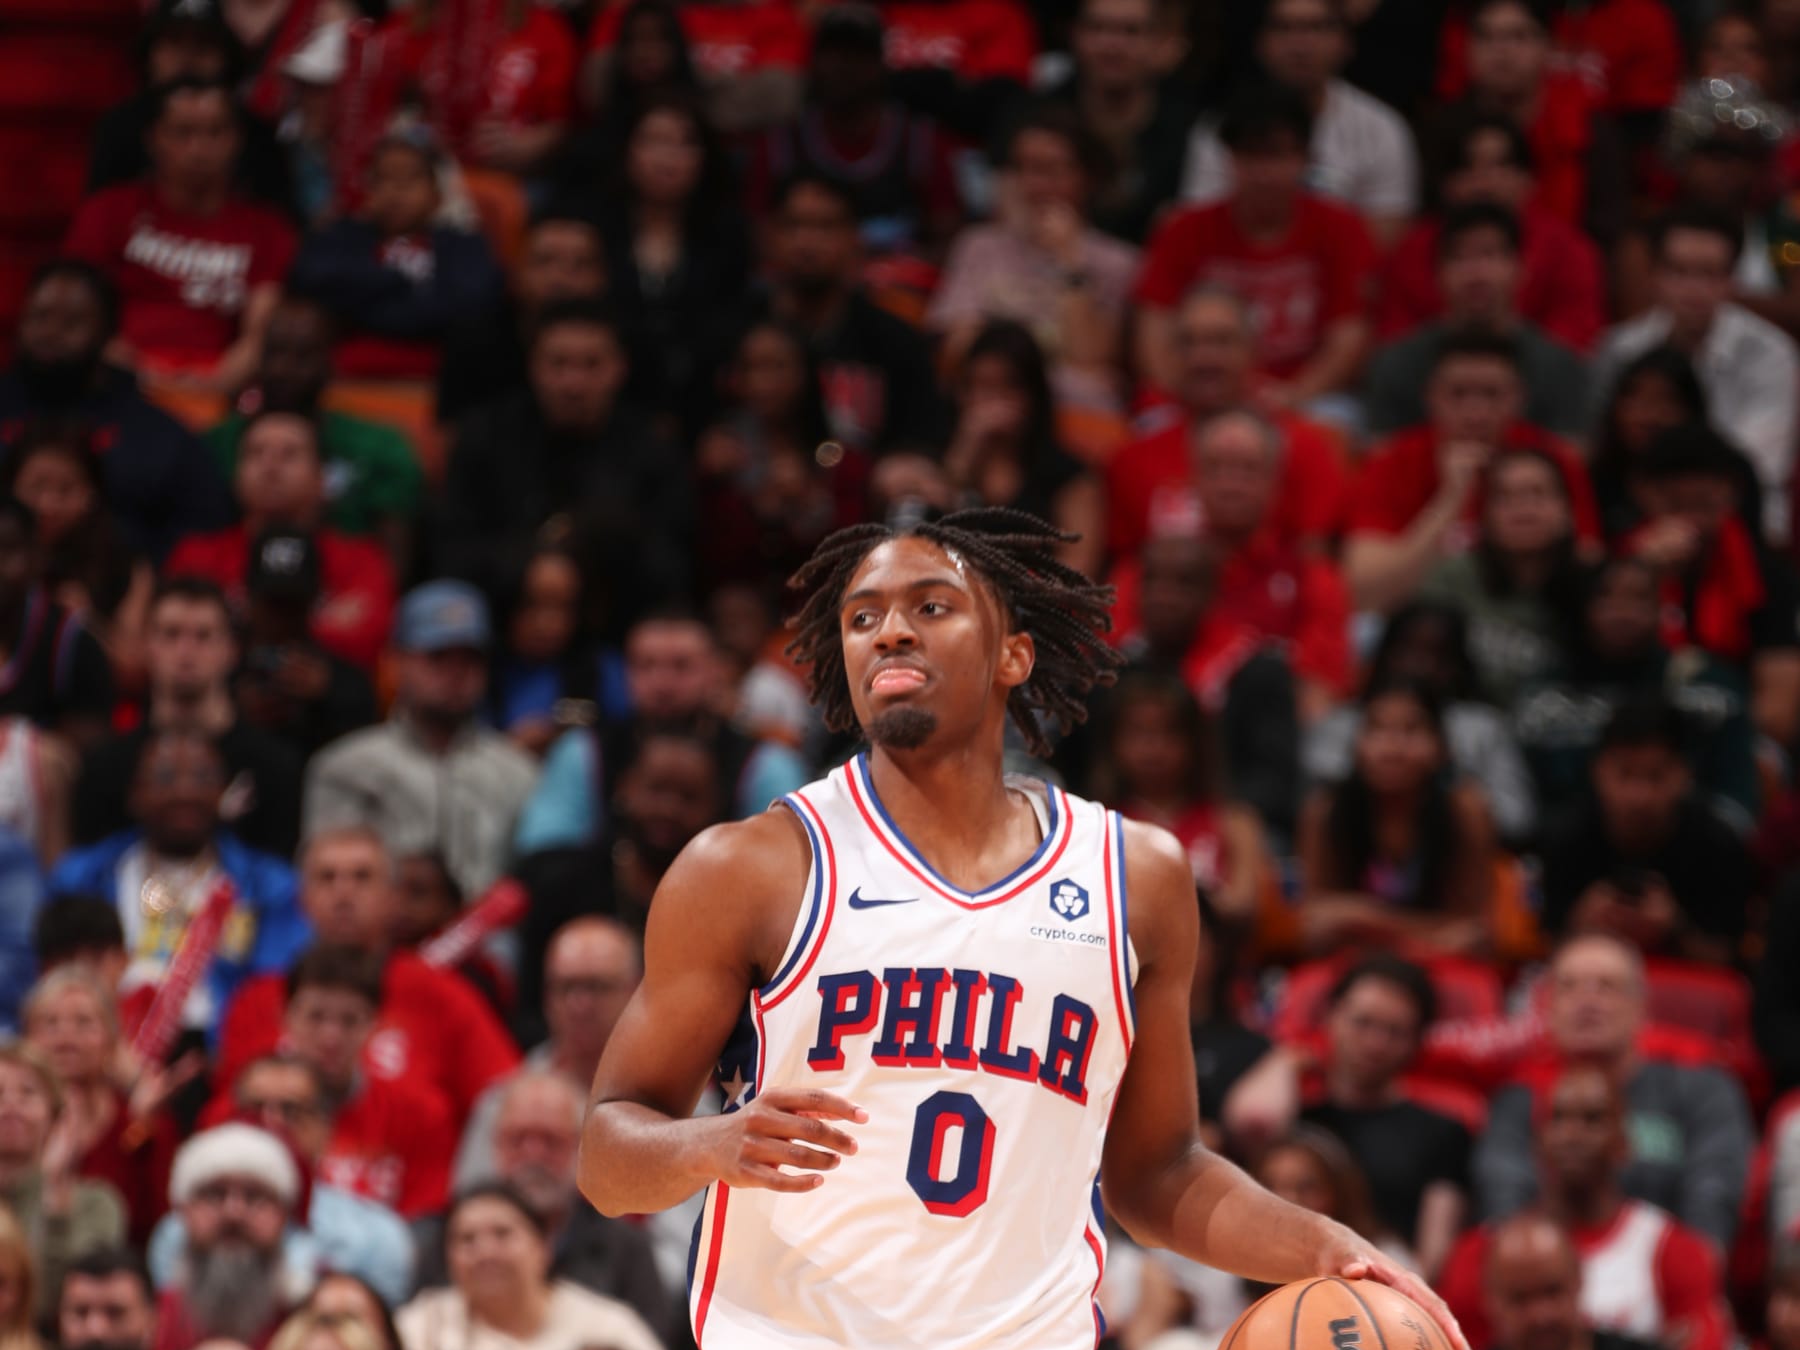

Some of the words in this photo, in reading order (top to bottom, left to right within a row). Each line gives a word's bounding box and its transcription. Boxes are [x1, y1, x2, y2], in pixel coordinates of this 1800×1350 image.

[1030, 926, 1106, 946] crypto.com
[807, 967, 1099, 1106] PHILA
[906, 1090, 997, 1218] 0
